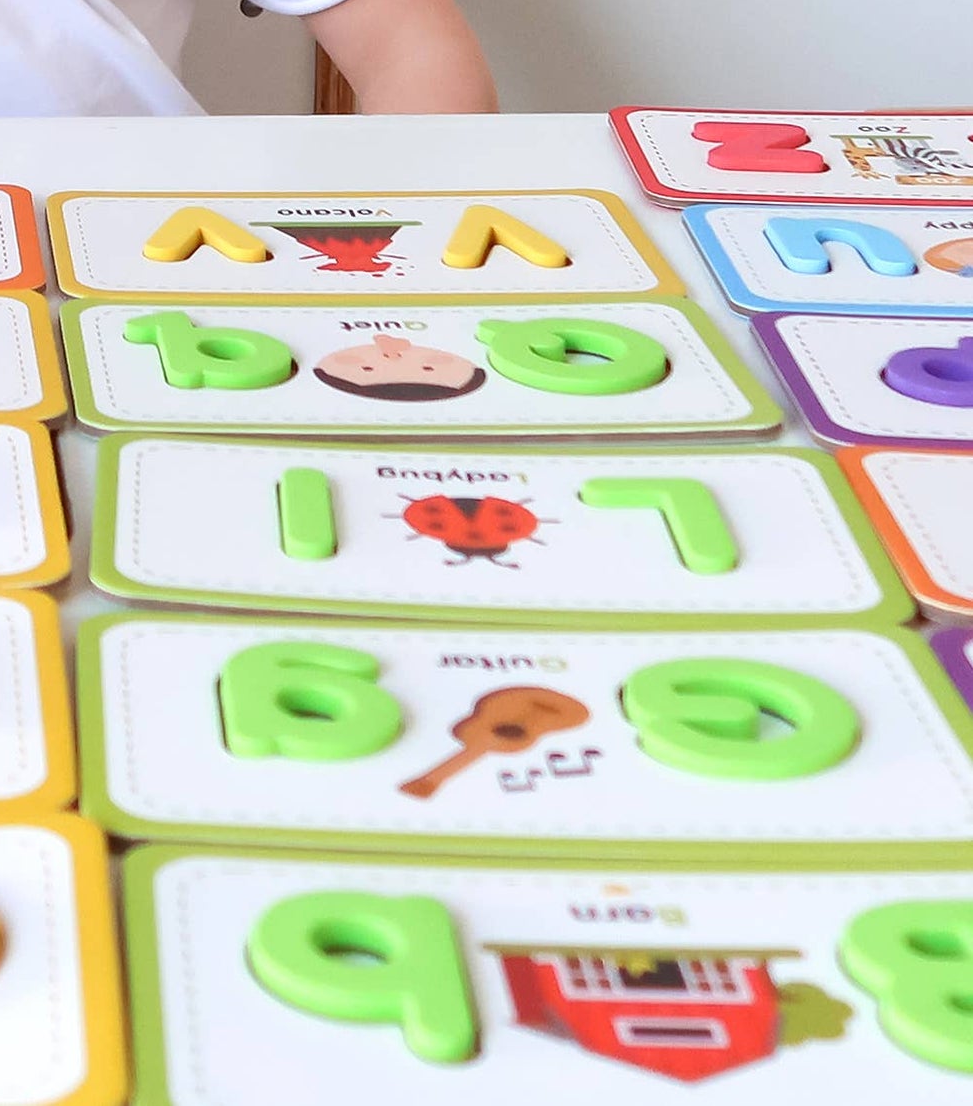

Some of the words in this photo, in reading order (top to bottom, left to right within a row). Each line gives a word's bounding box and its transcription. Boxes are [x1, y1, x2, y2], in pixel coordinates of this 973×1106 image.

[277, 208, 393, 217] Volcano
[443, 206, 572, 269] V
[126, 313, 298, 390] q
[340, 320, 428, 332] Quiet
[480, 320, 671, 395] Q
[377, 467, 529, 484] Ladybug
[582, 479, 737, 572] L
[437, 652, 569, 673] Guitar
[217, 643, 403, 759] g
[624, 660, 861, 779] G
[568, 903, 689, 927] Barn
[251, 893, 480, 1062] b
